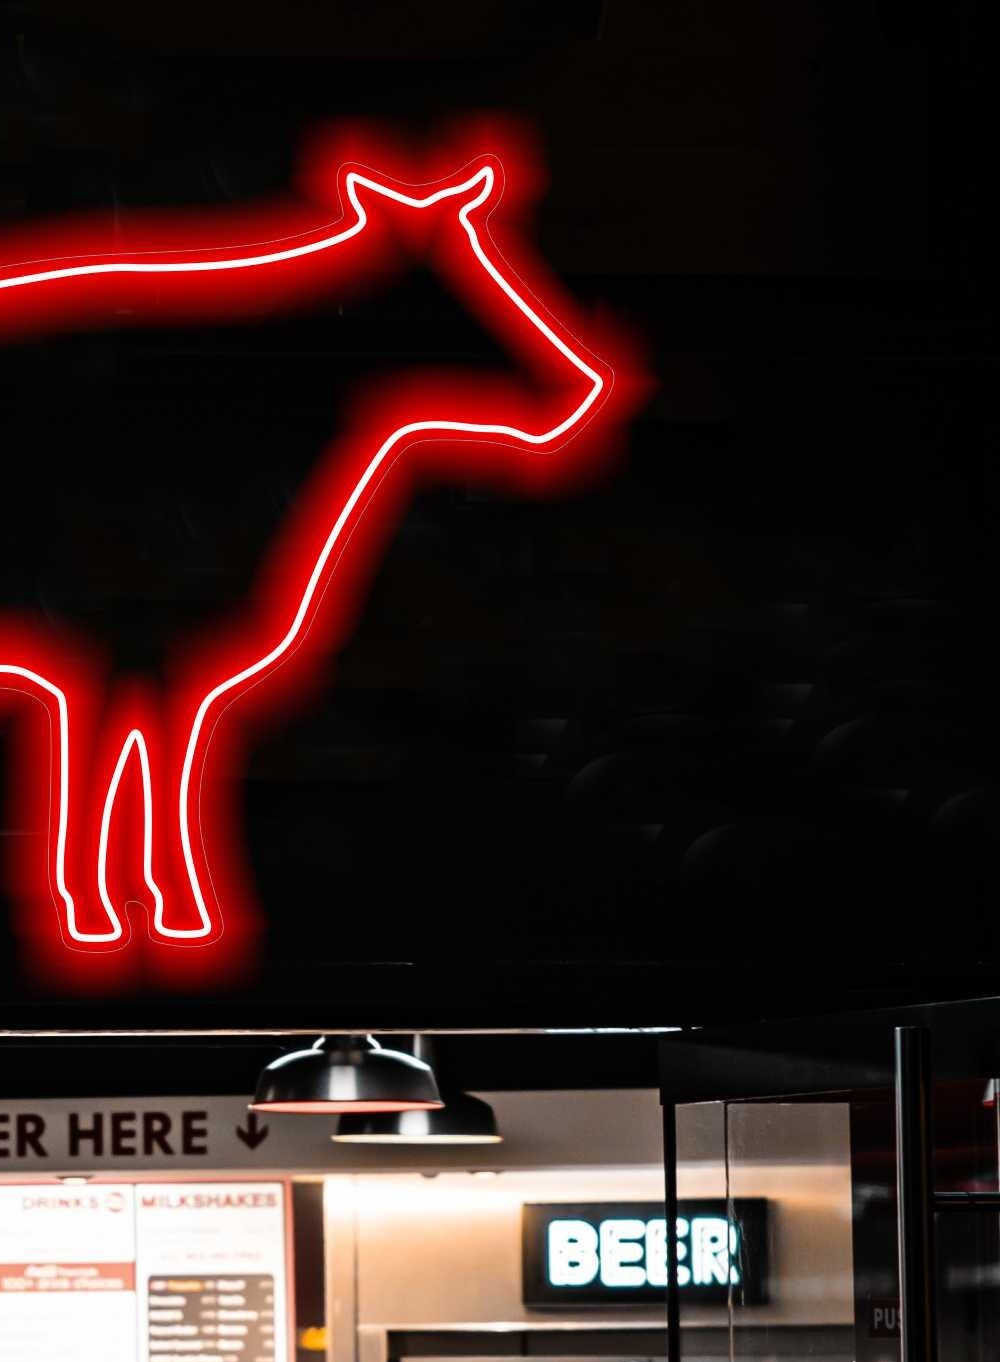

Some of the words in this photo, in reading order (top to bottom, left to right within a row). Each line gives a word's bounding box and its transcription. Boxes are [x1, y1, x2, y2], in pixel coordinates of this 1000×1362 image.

[68, 1110, 208, 1157] HERE
[22, 1196, 99, 1211] DRINKS
[140, 1192, 278, 1209] MILKSHAKES
[548, 1217, 740, 1287] BEER
